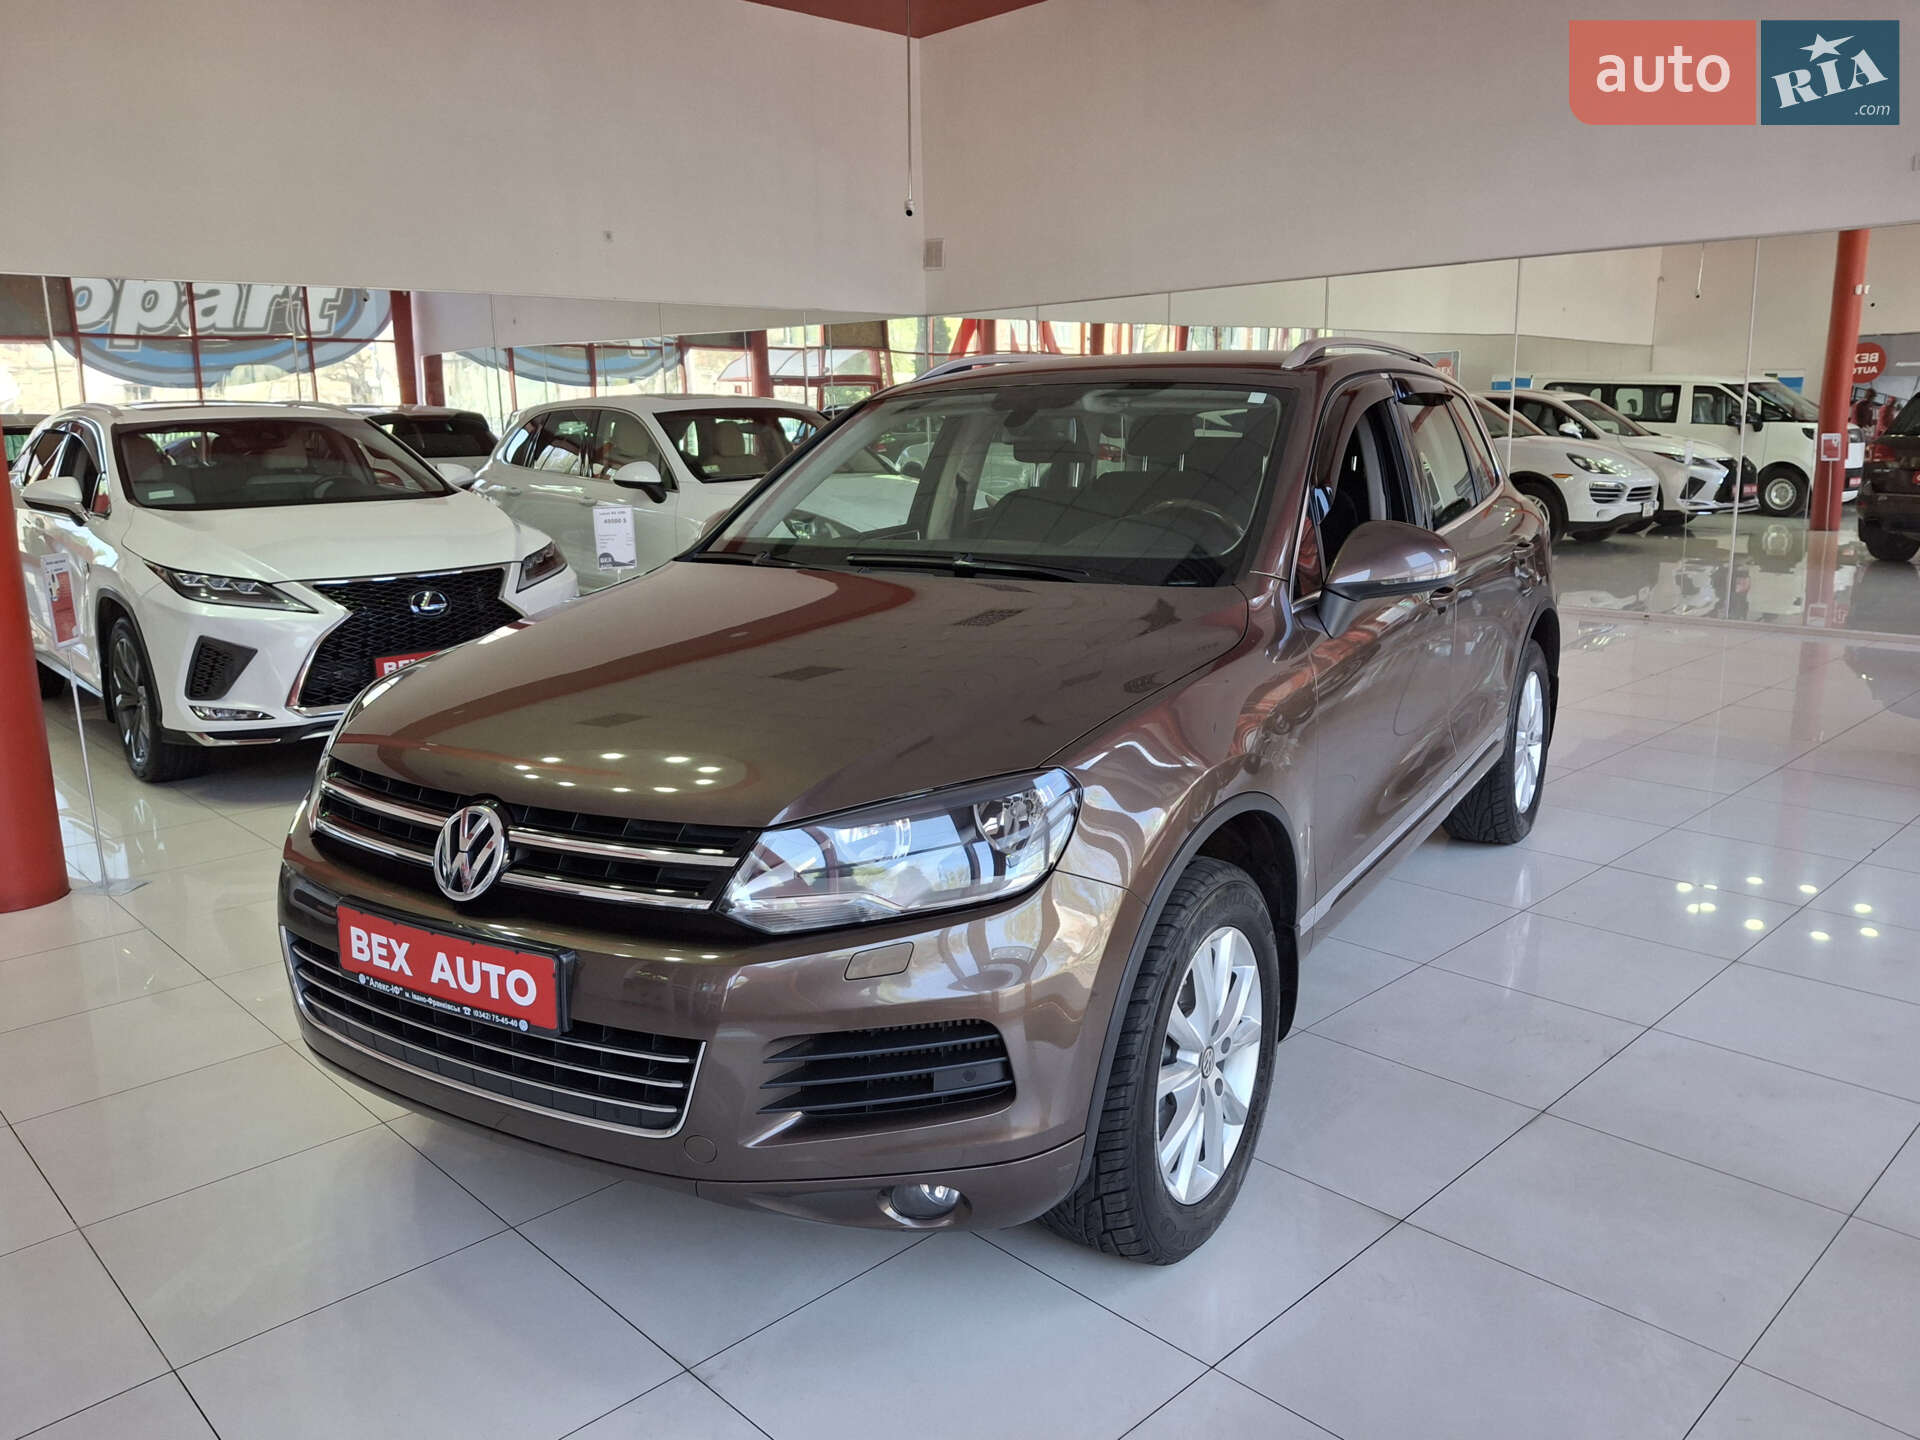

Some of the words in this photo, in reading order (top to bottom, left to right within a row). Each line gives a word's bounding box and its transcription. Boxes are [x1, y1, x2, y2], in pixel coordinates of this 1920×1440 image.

[383, 659, 416, 675] BE
[350, 926, 413, 977] BEX
[430, 952, 537, 1007] AUTO
